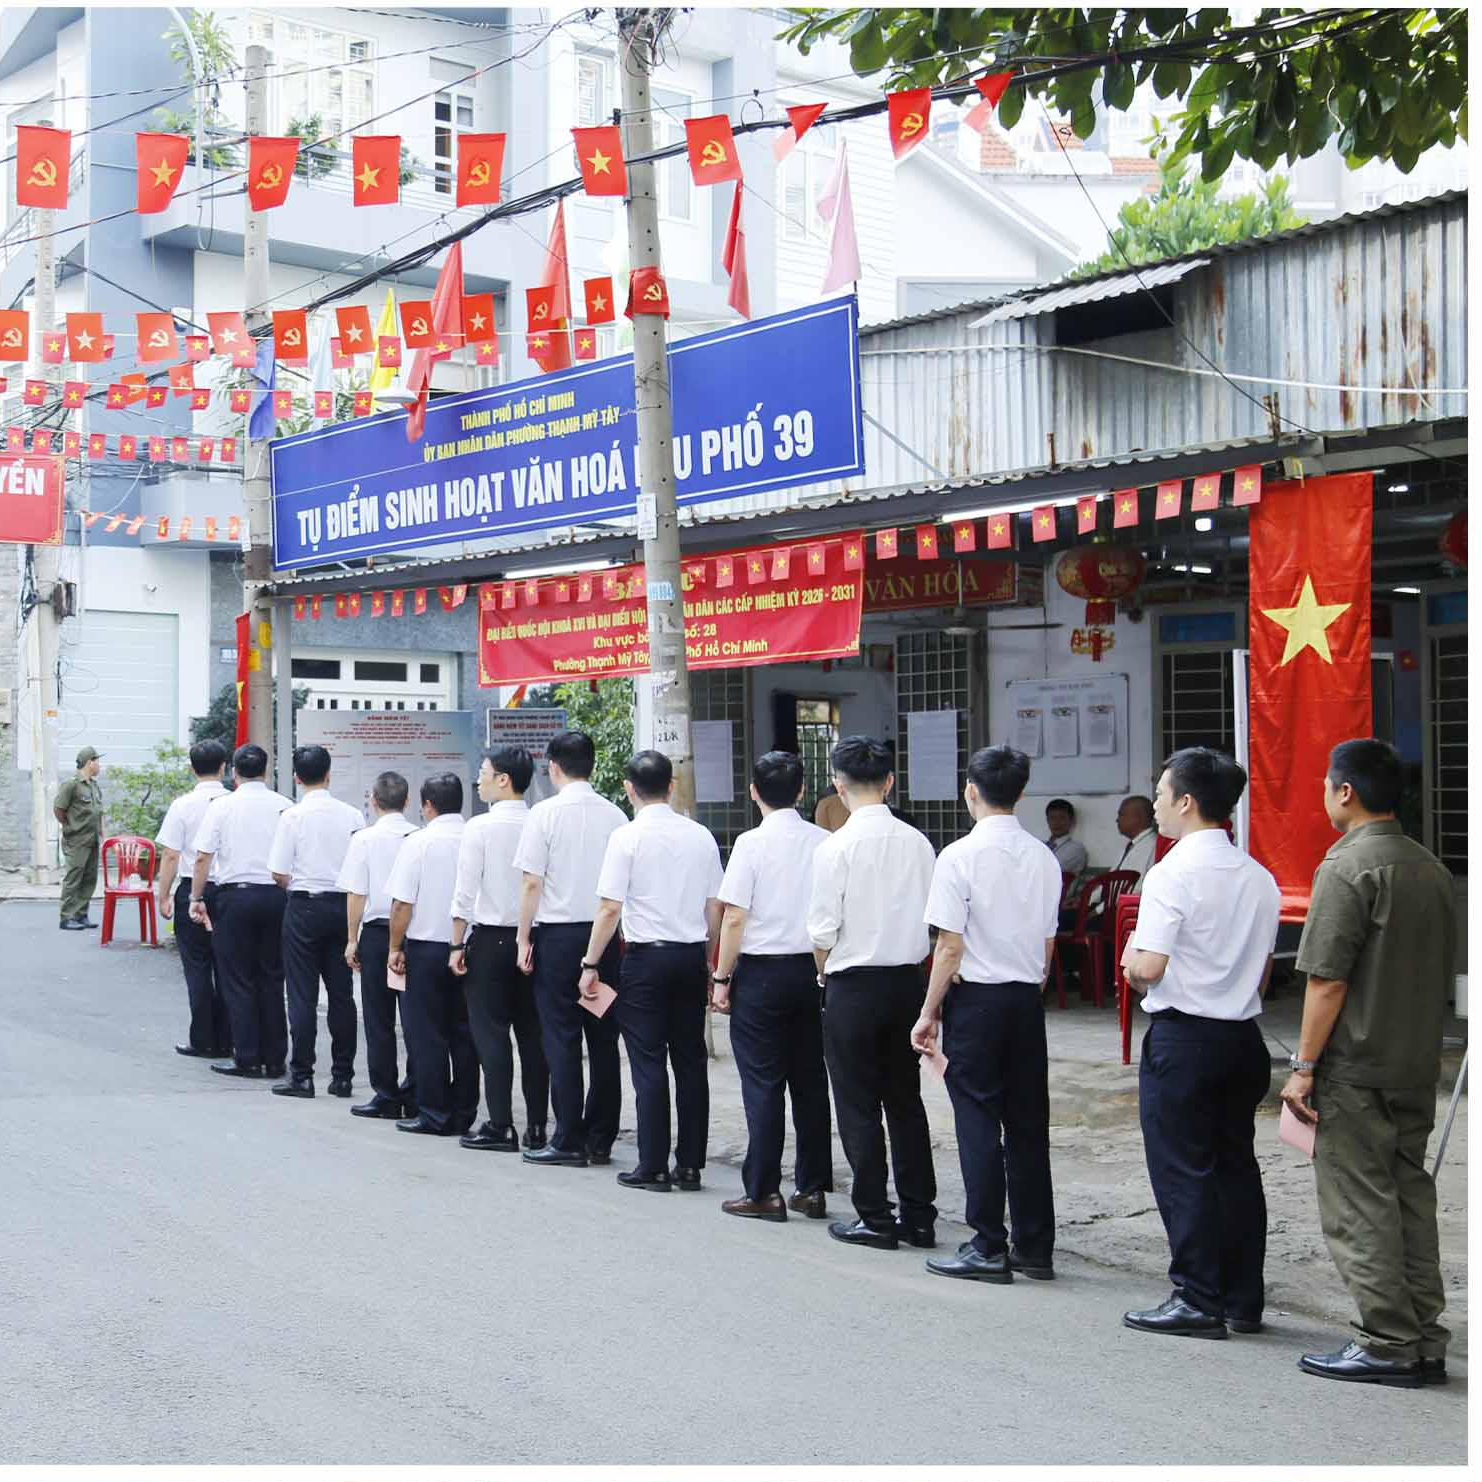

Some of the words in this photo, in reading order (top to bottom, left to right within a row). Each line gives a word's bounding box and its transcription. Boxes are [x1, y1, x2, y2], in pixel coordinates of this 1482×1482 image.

[492, 400, 513, 425] PHỐ
[529, 394, 546, 415] CHÍ
[548, 416, 581, 438] THẠNH
[583, 409, 599, 430] MỸ
[601, 406, 621, 426] TÂY
[297, 507, 322, 552] TỤ
[326, 484, 380, 541] ĐIỂM
[385, 484, 439, 530] SINH
[444, 472, 505, 523] HOẠT
[511, 456, 564, 510] VĂN
[571, 440, 627, 499] HOÁ
[701, 402, 765, 476] PHỐ
[773, 410, 814, 462] 39
[864, 573, 916, 601] VĂN
[593, 635, 613, 650] Khu
[615, 633, 635, 650] vực
[703, 623, 717, 637] 28
[587, 654, 616, 671] Thạnh
[722, 639, 740, 656] Chí
[743, 639, 768, 654] Minh
